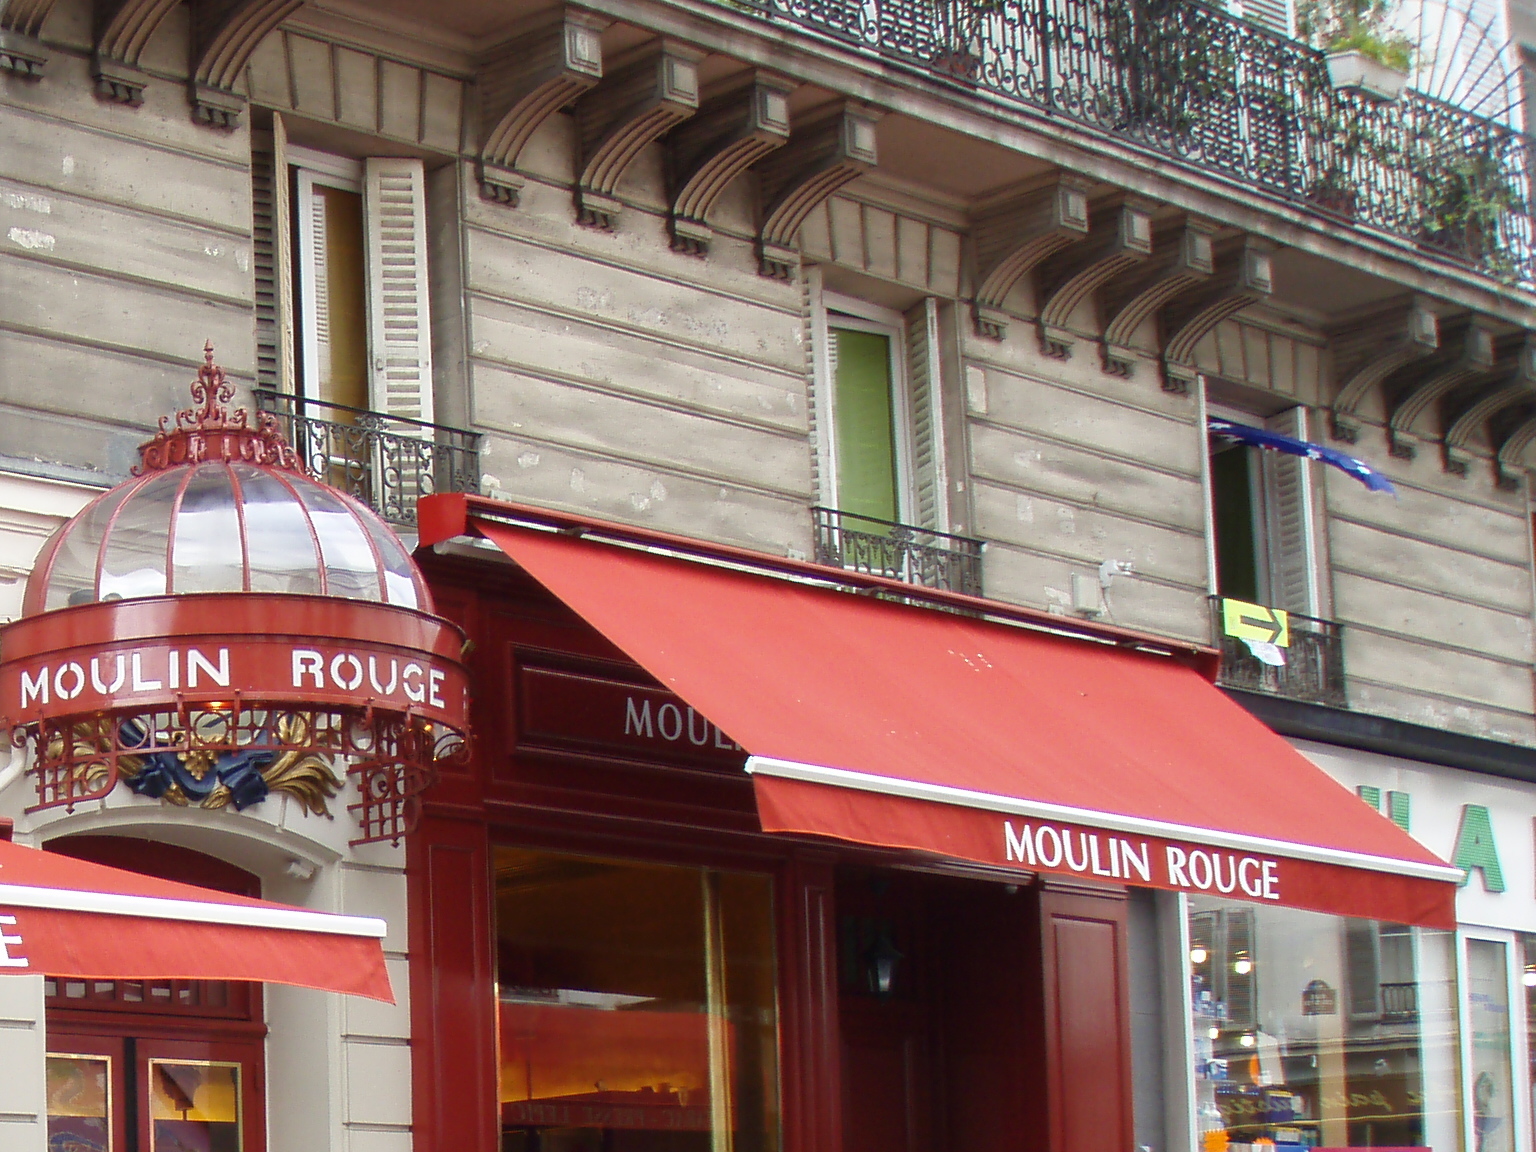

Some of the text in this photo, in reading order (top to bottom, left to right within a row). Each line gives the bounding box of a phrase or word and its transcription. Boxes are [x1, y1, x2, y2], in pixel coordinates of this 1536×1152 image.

[20, 648, 446, 709] MOULIN ROUGE
[624, 696, 742, 751] MOUL
[1003, 820, 1280, 900] MOULIN ROUGE
